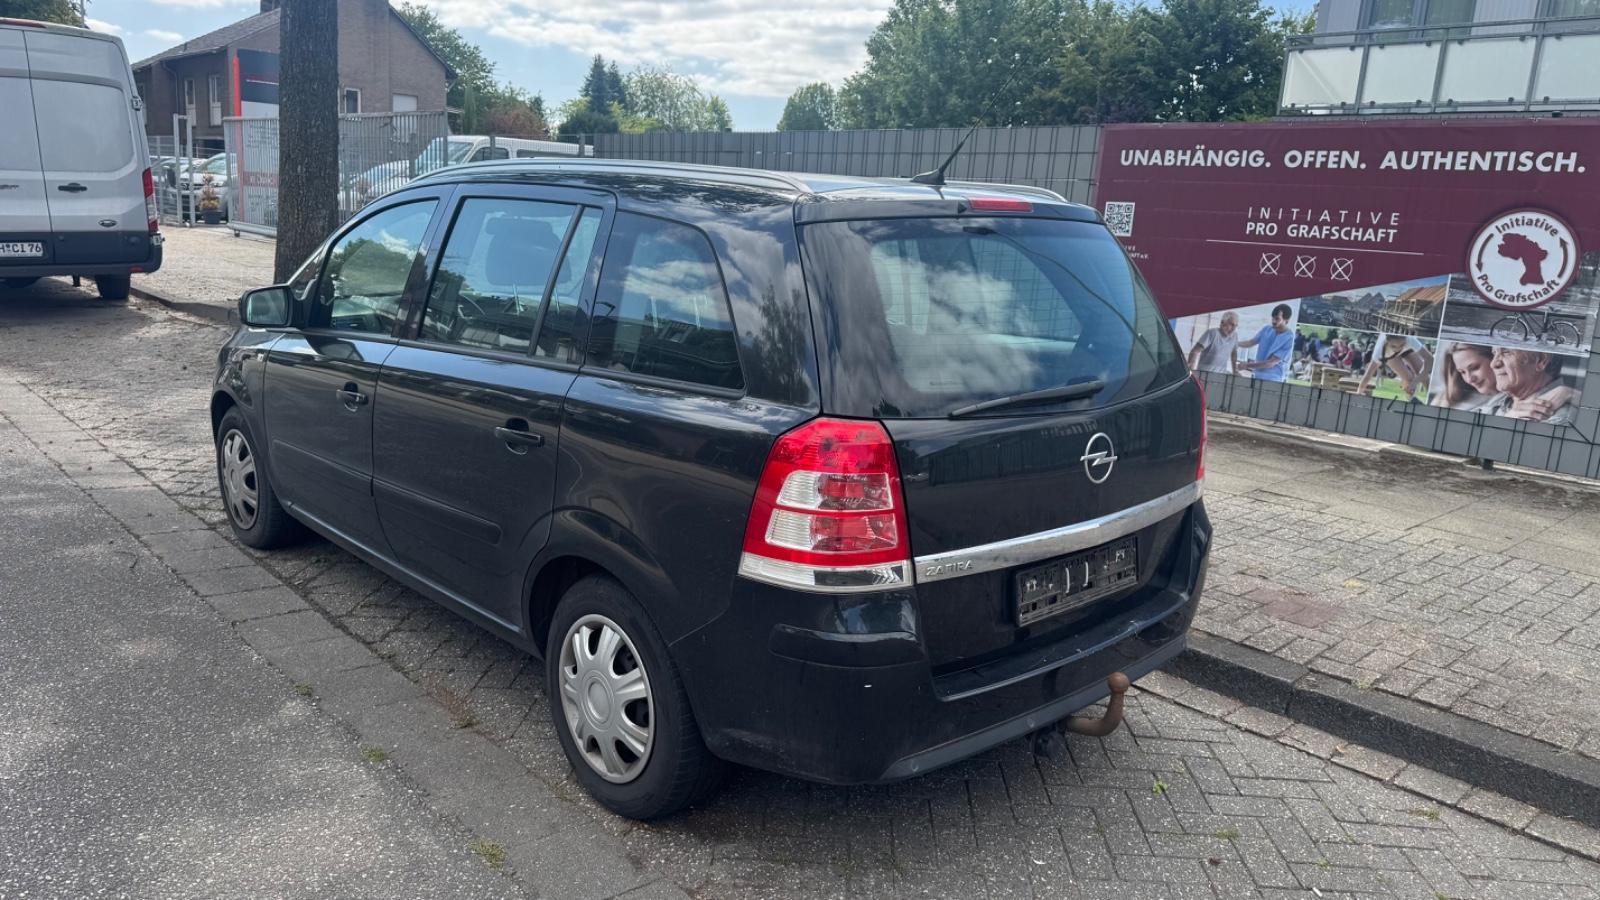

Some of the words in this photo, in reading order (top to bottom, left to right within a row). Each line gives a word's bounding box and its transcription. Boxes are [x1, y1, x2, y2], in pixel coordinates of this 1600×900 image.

[1120, 145, 1271, 168] UNABHÄNGIG.
[1284, 150, 1367, 170] OFFEN.
[1379, 151, 1586, 173] AUTHENTISCH.
[1248, 207, 1400, 226] INITIATIVE
[1495, 216, 1559, 237] Initiative
[1246, 222, 1278, 236] PRO
[1287, 224, 1397, 243] GRAFSCHAFT
[1477, 273, 1494, 293] Pro
[1494, 279, 1560, 303] Grafschaft
